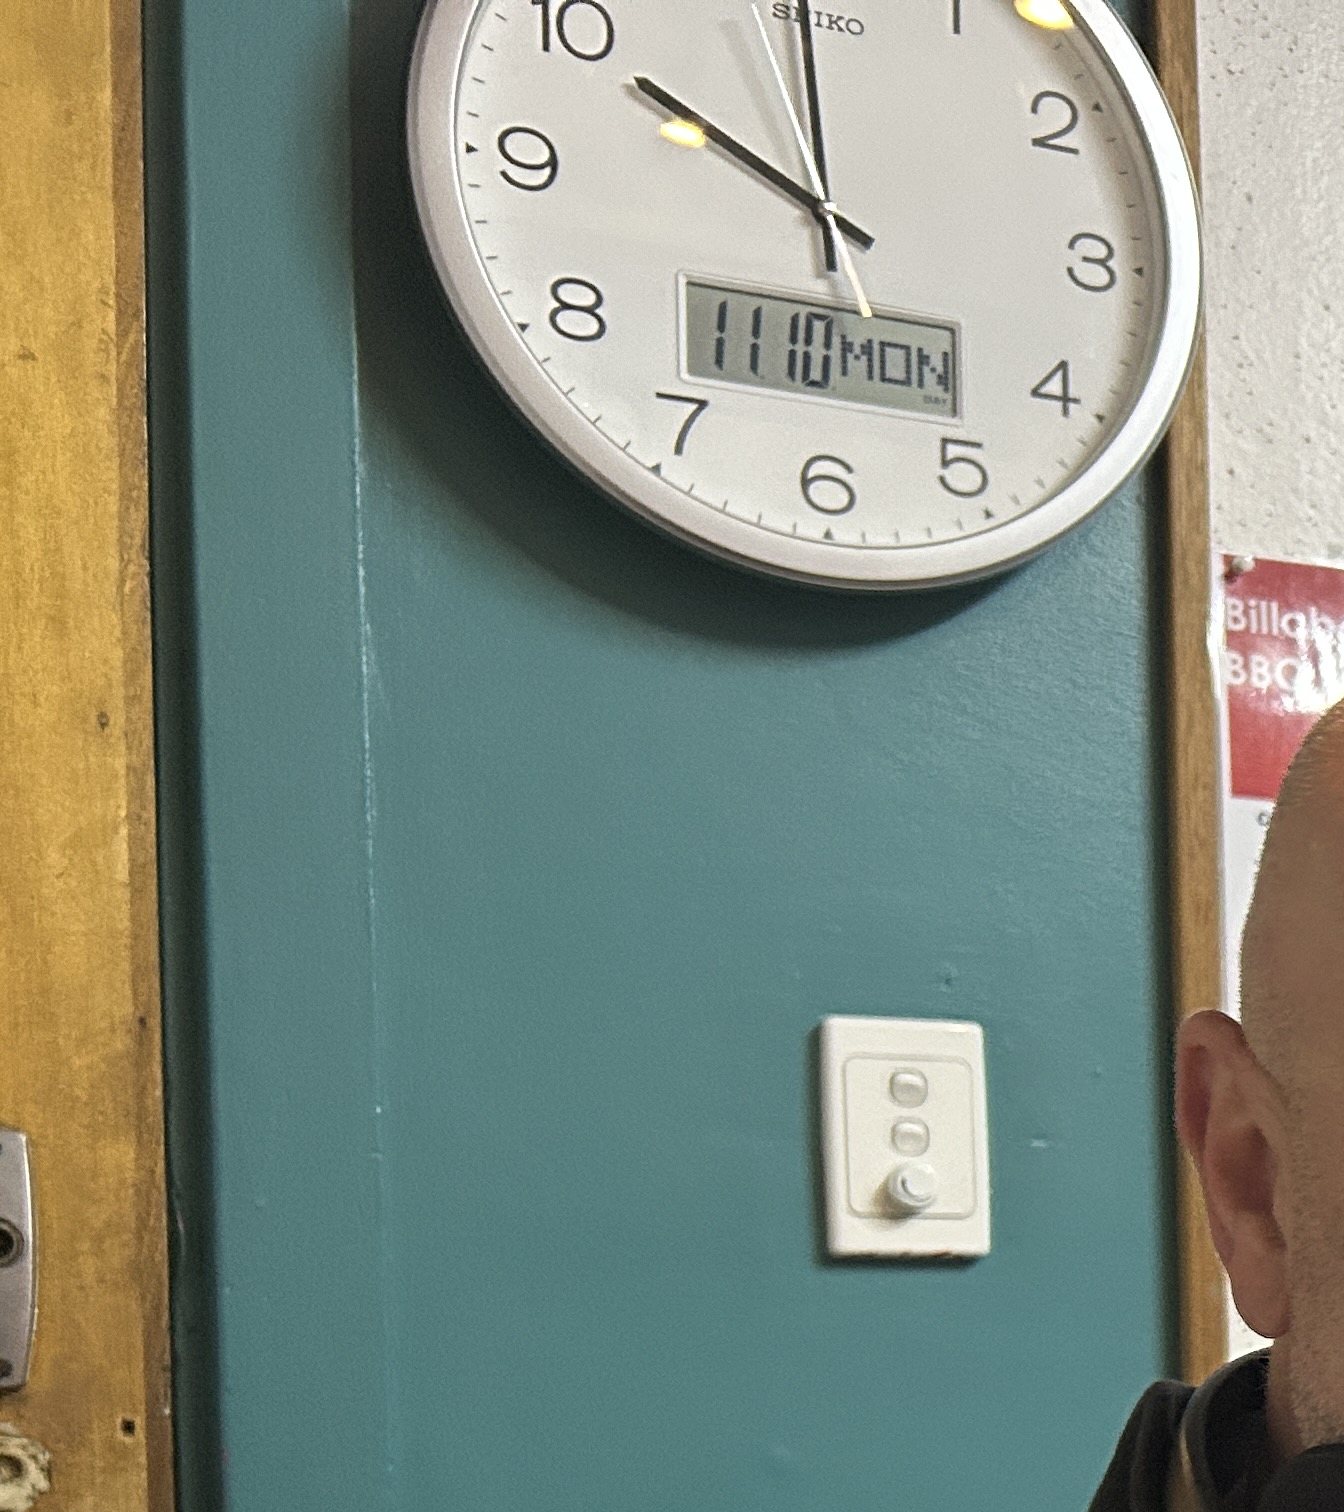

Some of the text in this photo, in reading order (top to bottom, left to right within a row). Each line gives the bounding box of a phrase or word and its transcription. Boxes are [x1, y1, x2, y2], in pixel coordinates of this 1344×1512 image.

[1030, 91, 1080, 154] 2
[499, 126, 559, 191] 9
[1066, 233, 1118, 293] 3
[548, 277, 607, 342] 8
[840, 334, 949, 393] MON
[1030, 360, 1081, 417] 4
[655, 392, 709, 456] 7
[800, 454, 856, 515] 6
[937, 438, 989, 498] 5
